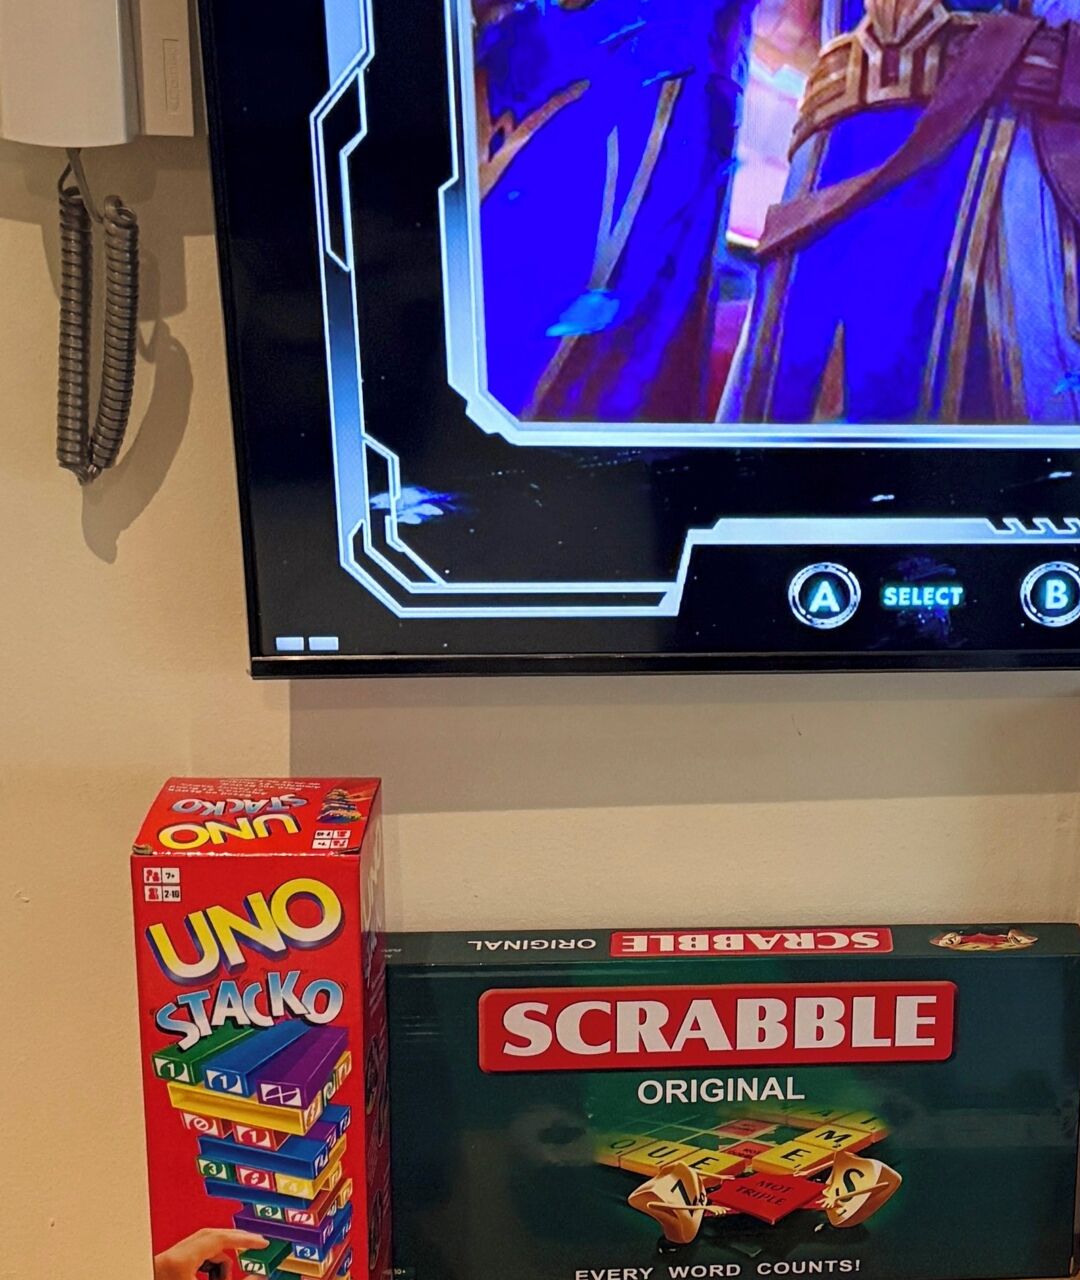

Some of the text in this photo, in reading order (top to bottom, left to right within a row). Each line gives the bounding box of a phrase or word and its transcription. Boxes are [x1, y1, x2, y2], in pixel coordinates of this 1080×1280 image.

[808, 580, 963, 613] A SELECT
[1045, 579, 1069, 610] B
[172, 793, 309, 817] STACKO
[158, 813, 301, 850] UNO
[147, 877, 343, 981] UNO
[468, 930, 880, 953] ORIGINAL SCRABBLE
[155, 970, 344, 1051] STACKO
[501, 994, 938, 1057] SCRABBLE
[636, 1076, 806, 1105] ORIGINAL
[734, 1184, 786, 1206] TRIPLE
[755, 1179, 793, 1195] MOT
[668, 1262, 741, 1279] WORD
[756, 1258, 861, 1276] COUNTS!
